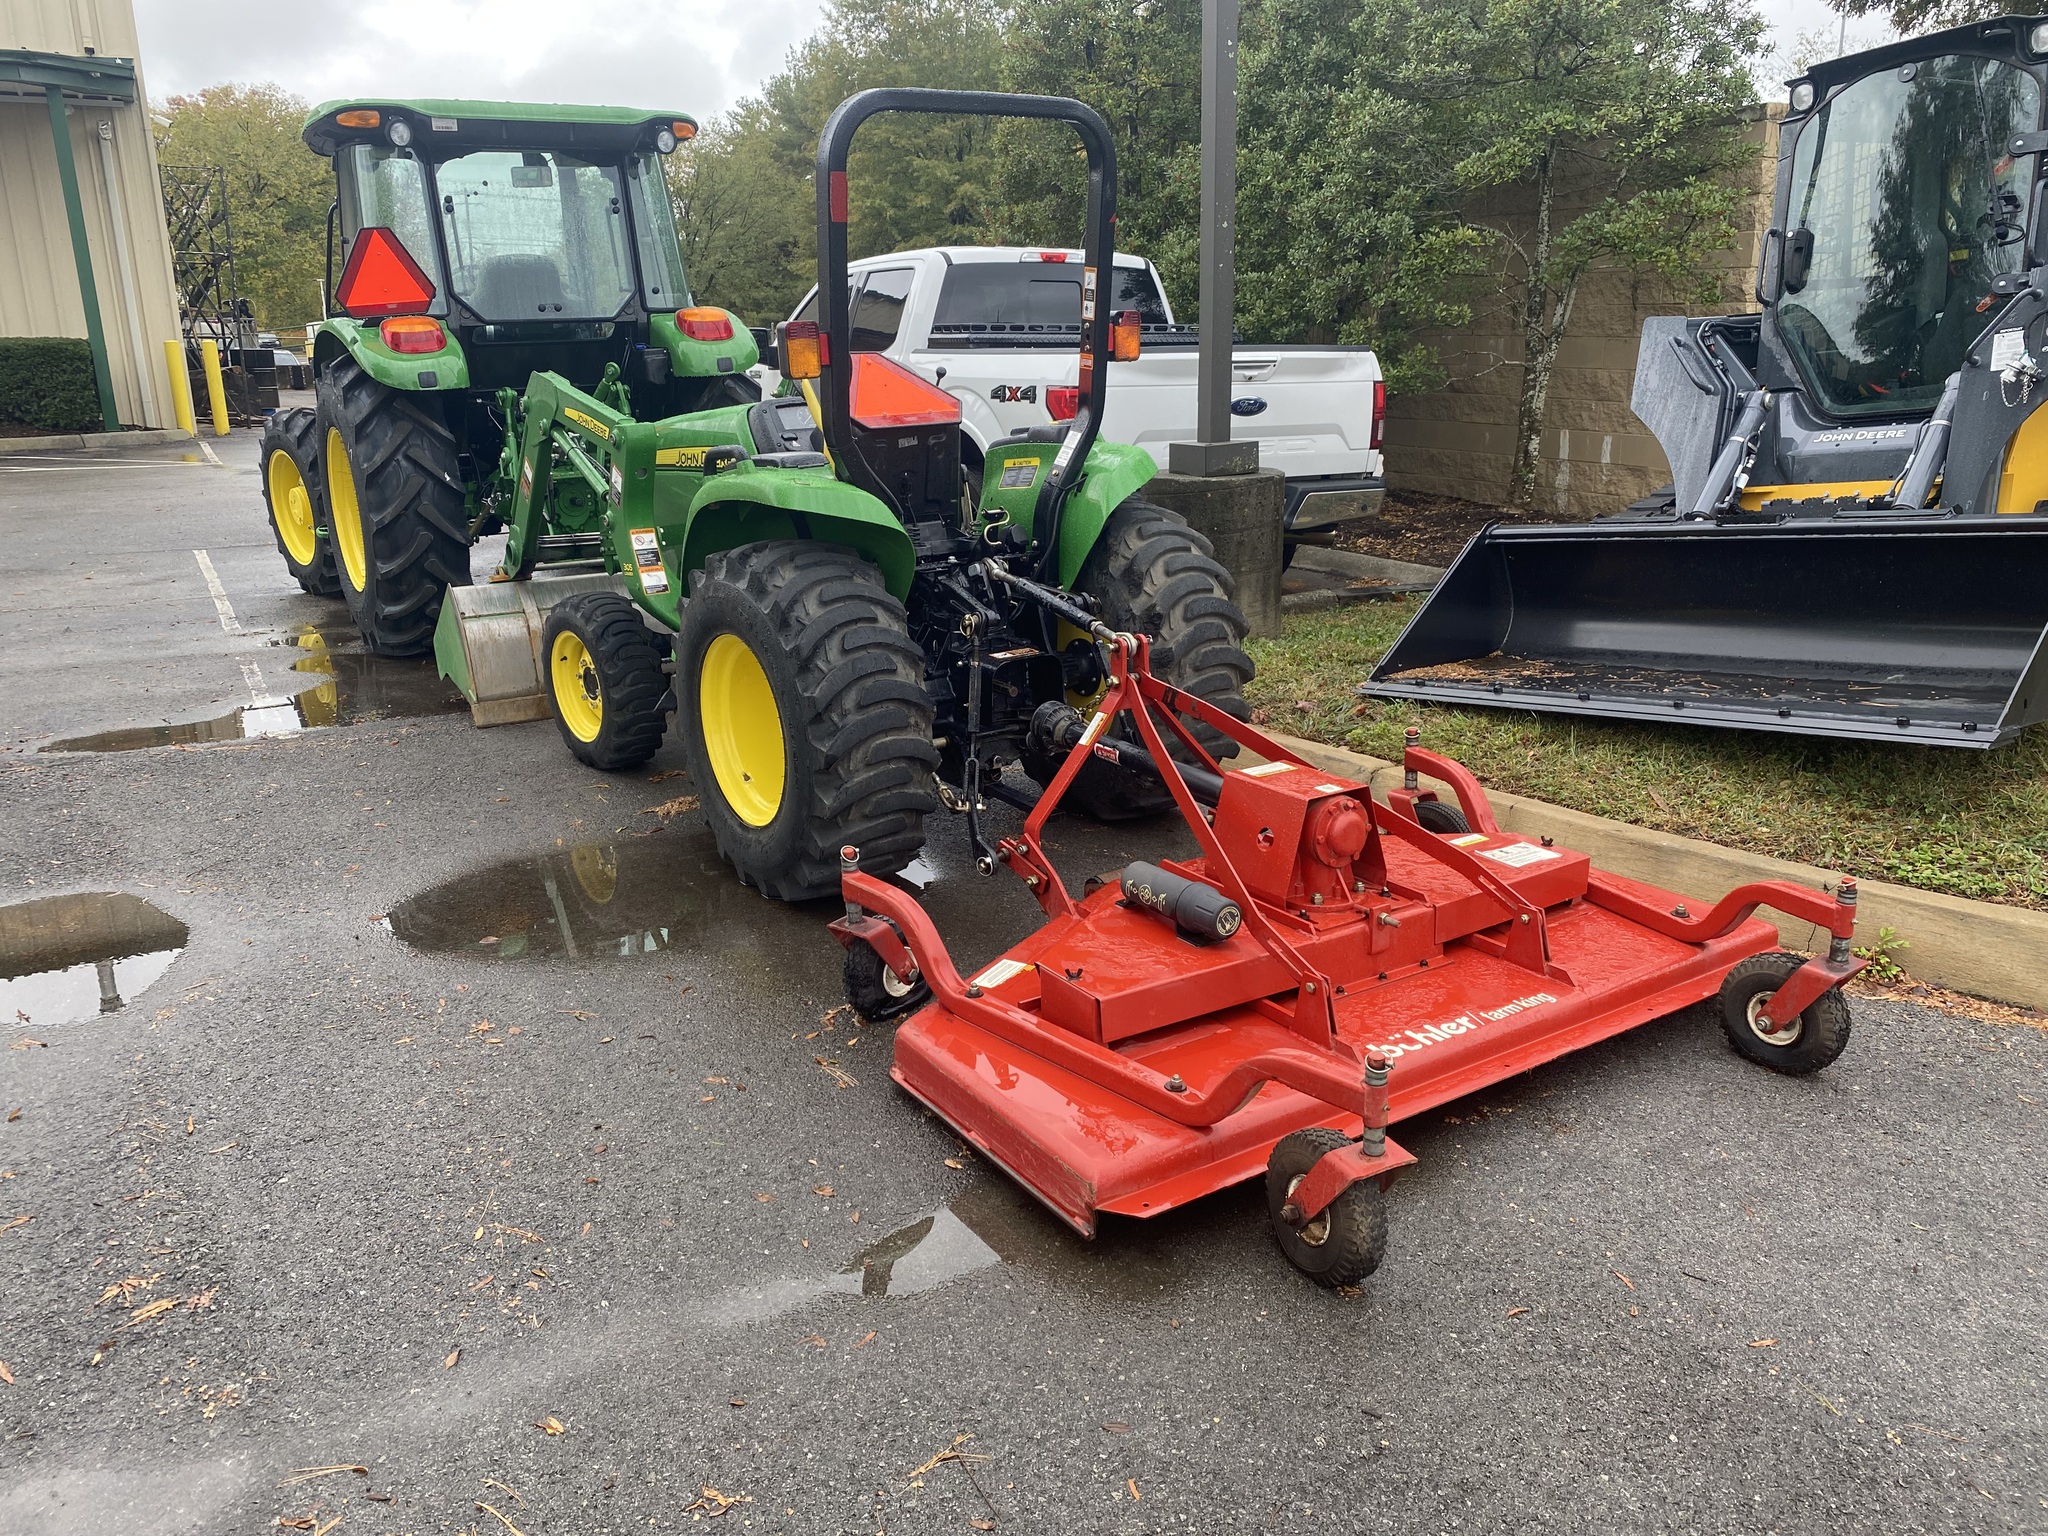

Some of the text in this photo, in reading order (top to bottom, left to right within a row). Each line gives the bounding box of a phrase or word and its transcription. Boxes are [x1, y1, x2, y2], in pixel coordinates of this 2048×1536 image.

[1237, 400, 1260, 412] Ford
[576, 412, 608, 438] JOHN DEERE
[1813, 429, 1908, 443] JOHN DEERE
[675, 450, 699, 467] JOHN
[1512, 992, 1557, 1008] king
